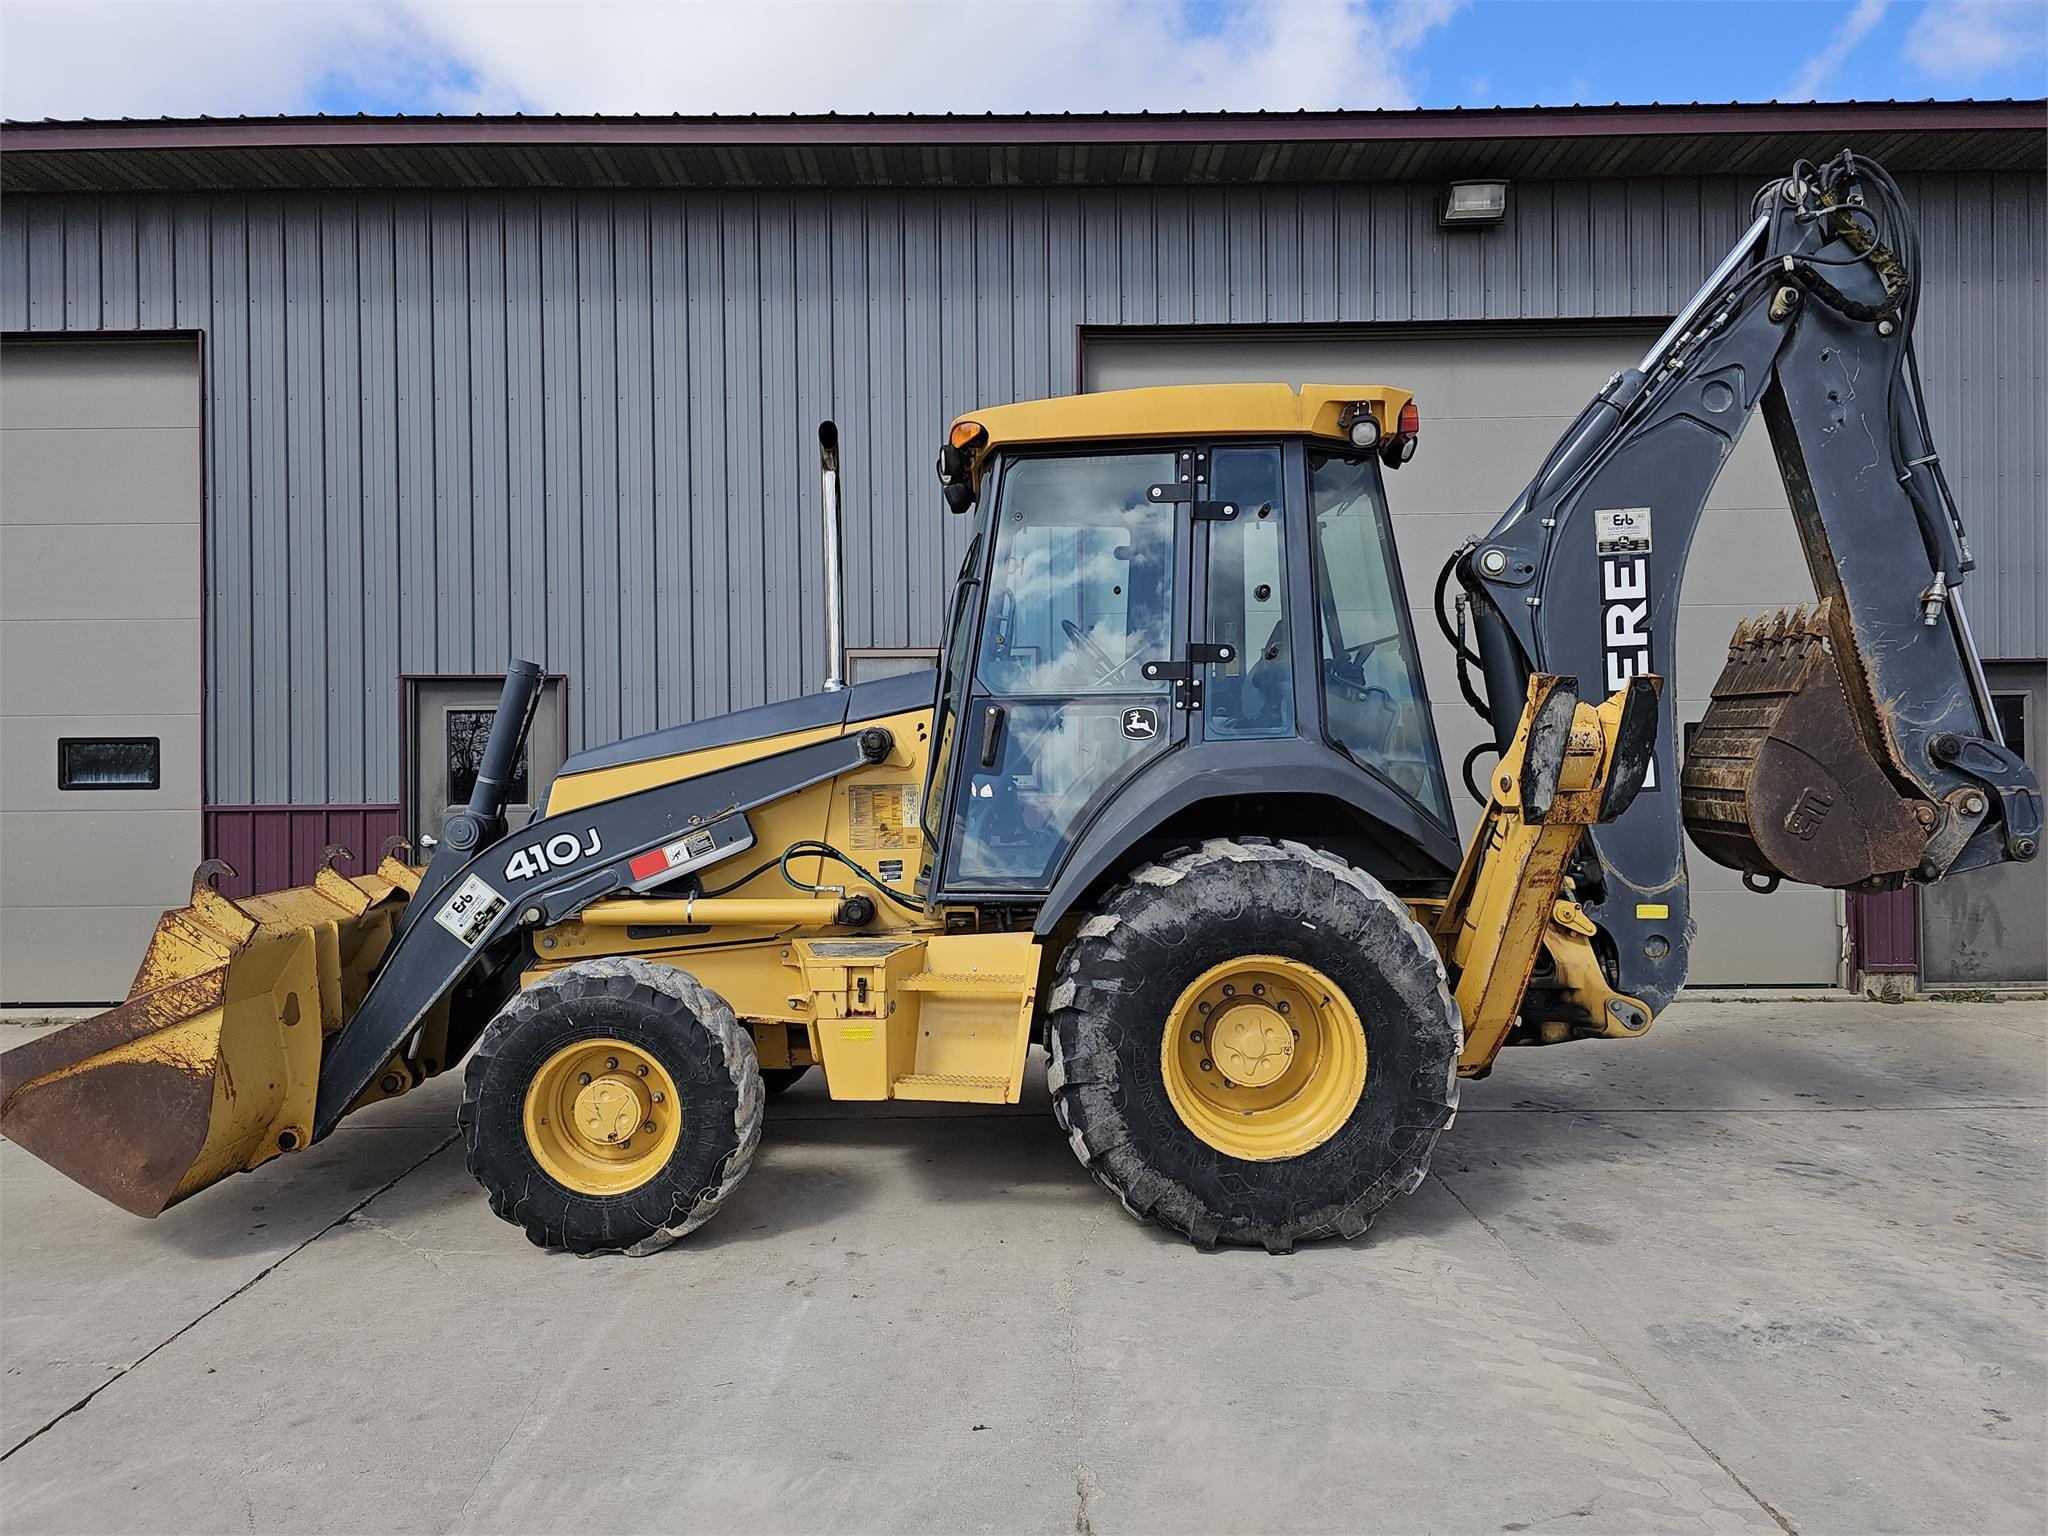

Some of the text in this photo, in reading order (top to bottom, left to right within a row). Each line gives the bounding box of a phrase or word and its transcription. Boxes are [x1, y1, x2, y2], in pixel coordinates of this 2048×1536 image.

[1613, 514, 1634, 526] Erb
[504, 828, 602, 881] 410J
[451, 892, 473, 914] Erb
